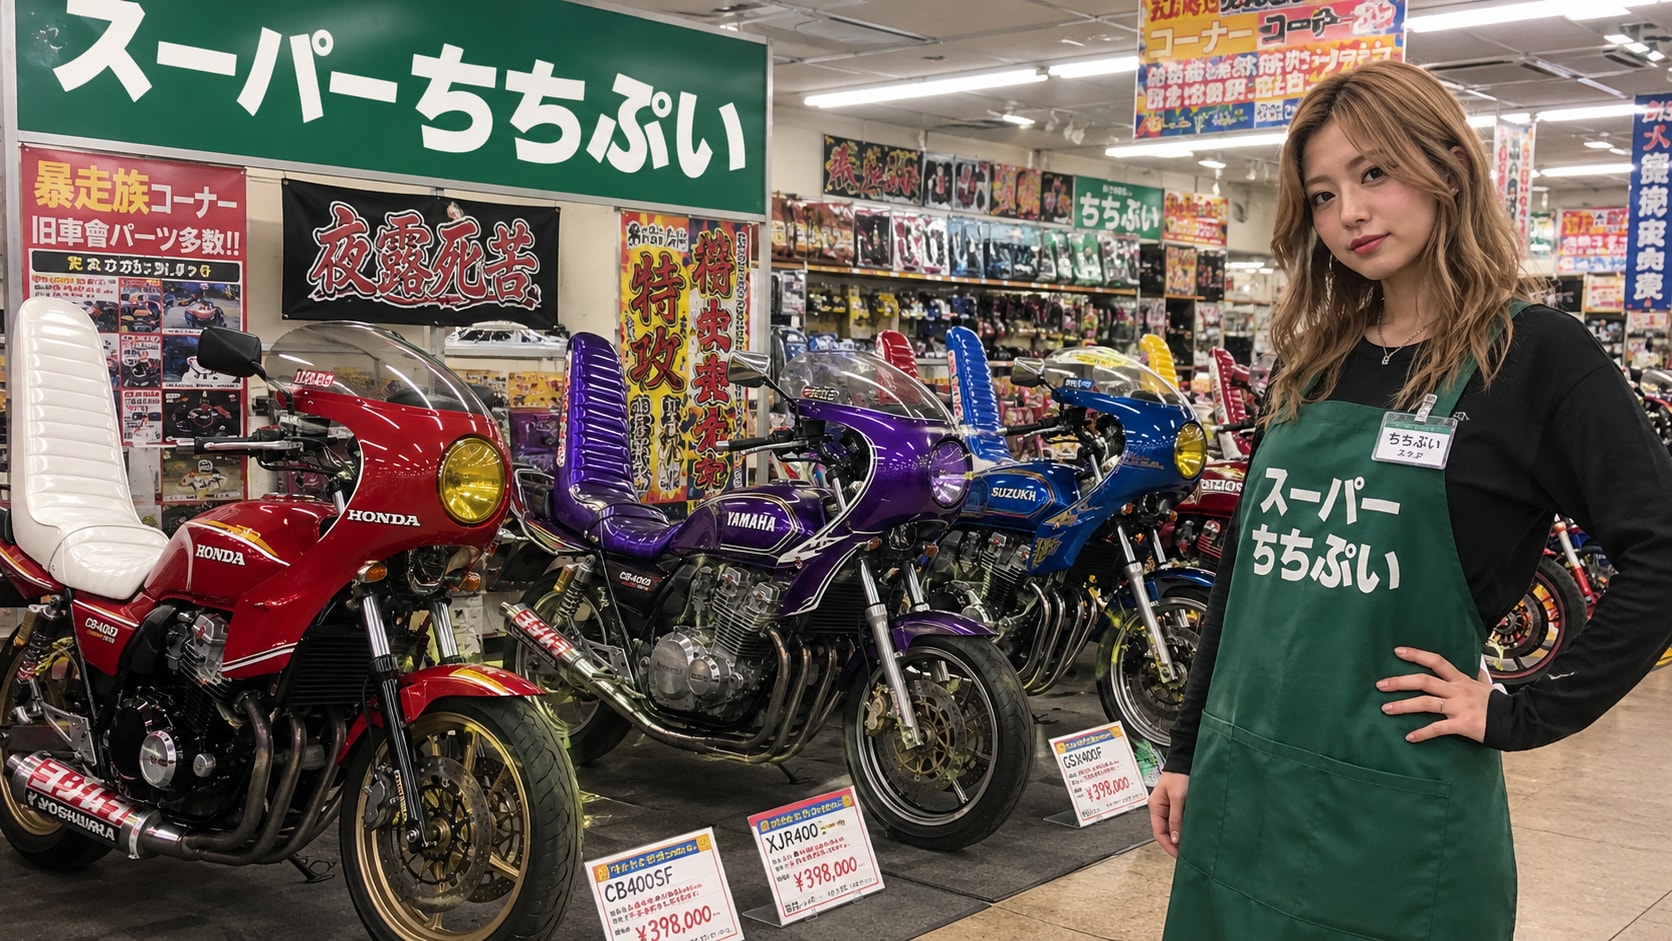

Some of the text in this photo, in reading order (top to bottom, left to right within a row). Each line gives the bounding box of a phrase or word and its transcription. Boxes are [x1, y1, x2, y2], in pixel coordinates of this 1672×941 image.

[53, 0, 747, 179] スーパーちちぷい
[34, 160, 238, 219] 暴走族コーナー
[32, 215, 240, 256] 旧車會パーツ多数!!
[307, 201, 540, 306] 夜露死苦
[628, 251, 688, 394] 特攻
[1260, 467, 1400, 525] スーパー
[347, 509, 421, 527] HONDA
[726, 511, 776, 532] YAMAHA
[195, 543, 246, 566] HONDA
[1252, 523, 1400, 594] ちちぷい
[1062, 746, 1102, 769] GSX400F
[1086, 776, 1130, 802] ¥398,000
[766, 823, 818, 854] XJR400
[604, 866, 674, 903] CB400SF
[793, 856, 858, 893] ¥398,000
[635, 905, 713, 941] ¥398,000
